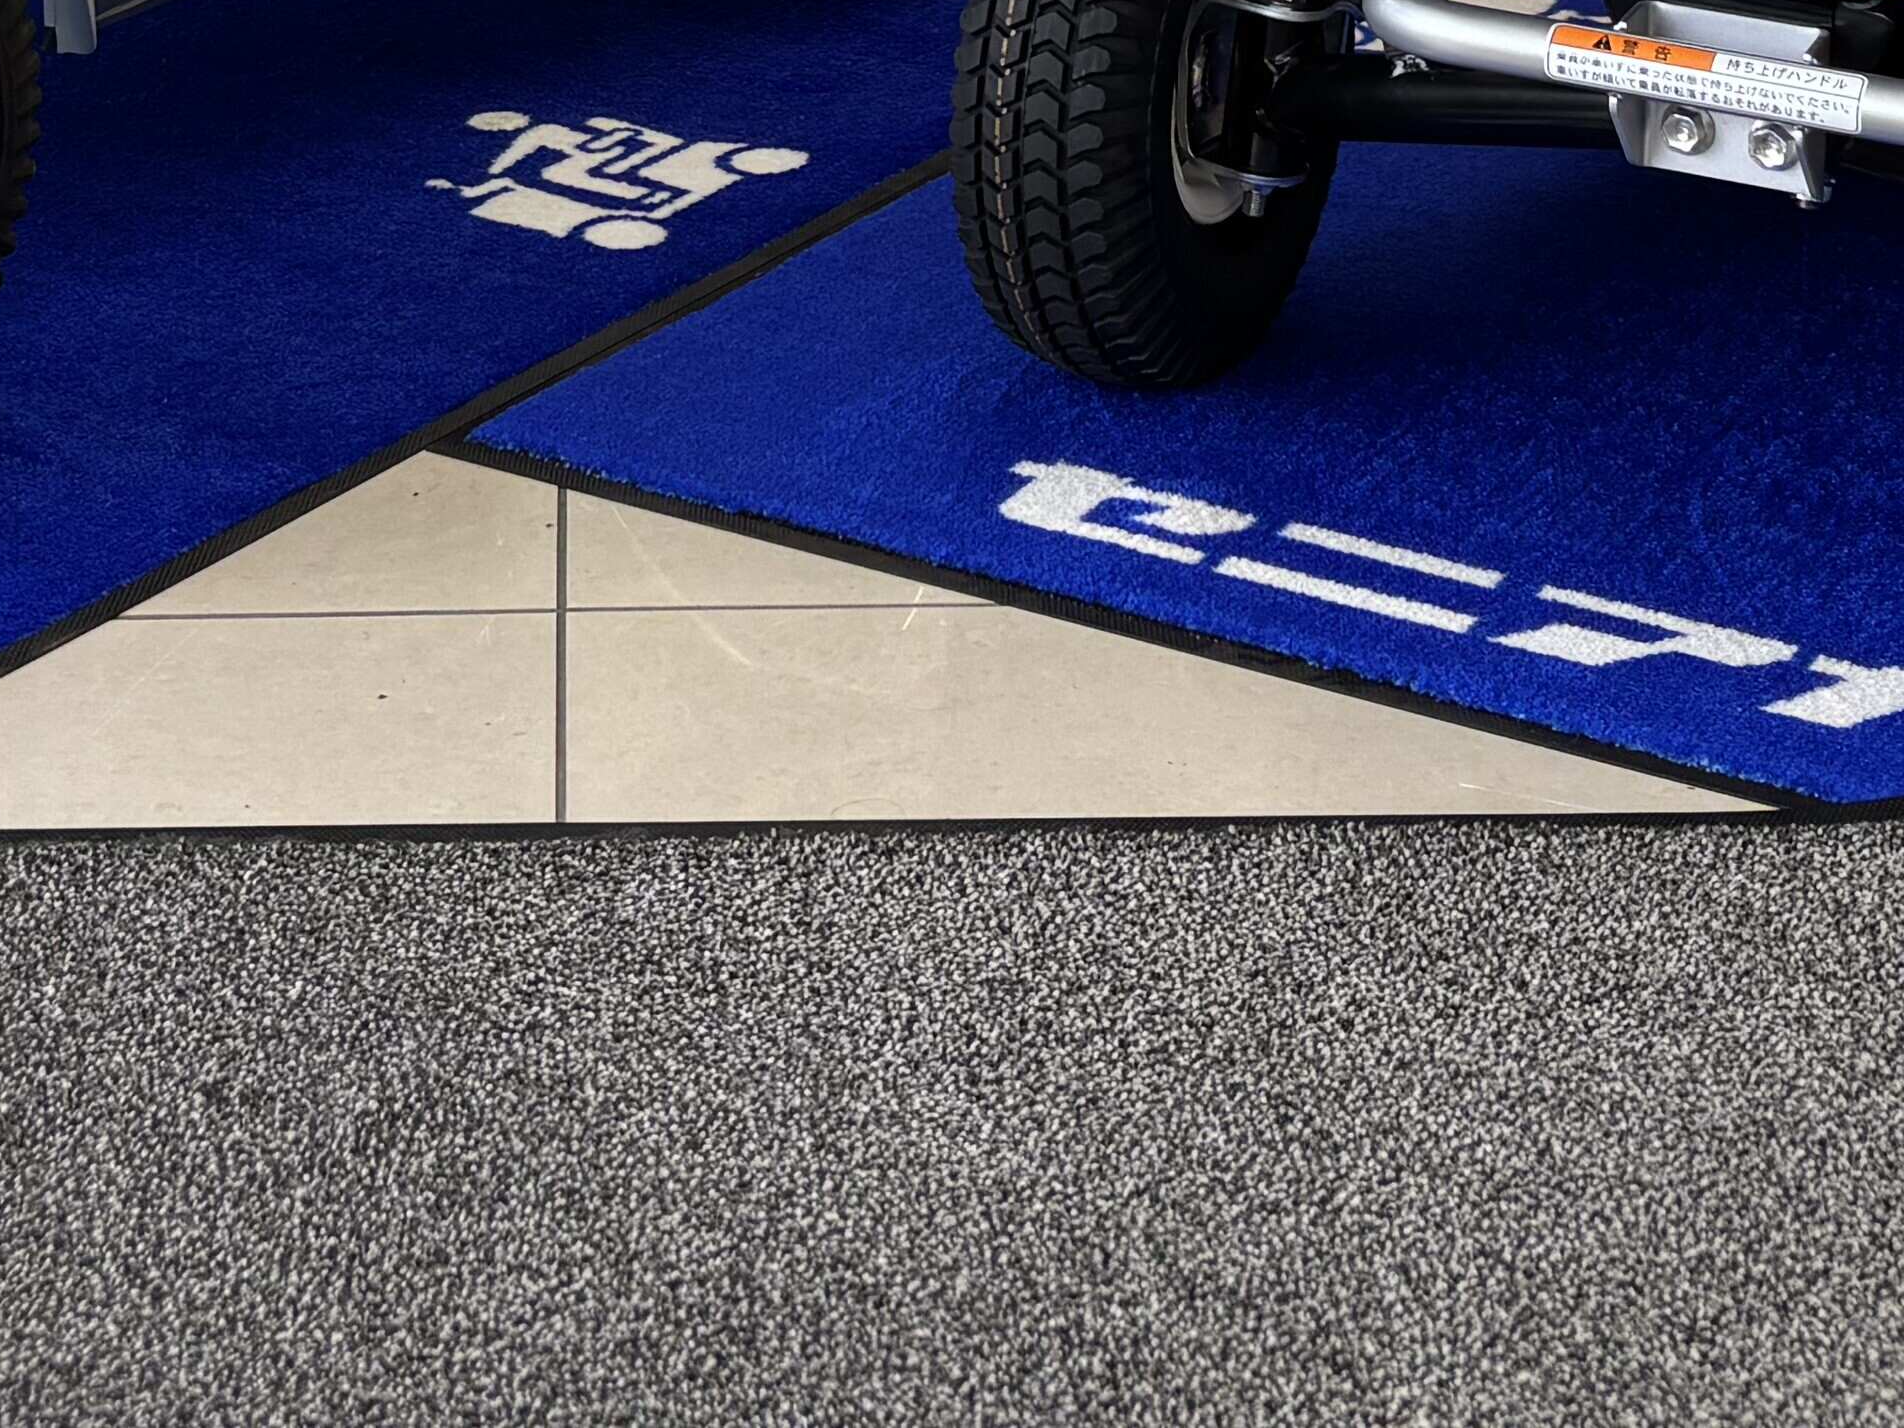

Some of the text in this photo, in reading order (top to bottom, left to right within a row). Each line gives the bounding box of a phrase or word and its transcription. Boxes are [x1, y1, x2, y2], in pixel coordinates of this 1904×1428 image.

[1622, 39, 1673, 62] 警告
[1726, 57, 1849, 91] 持ち上げハンドル
